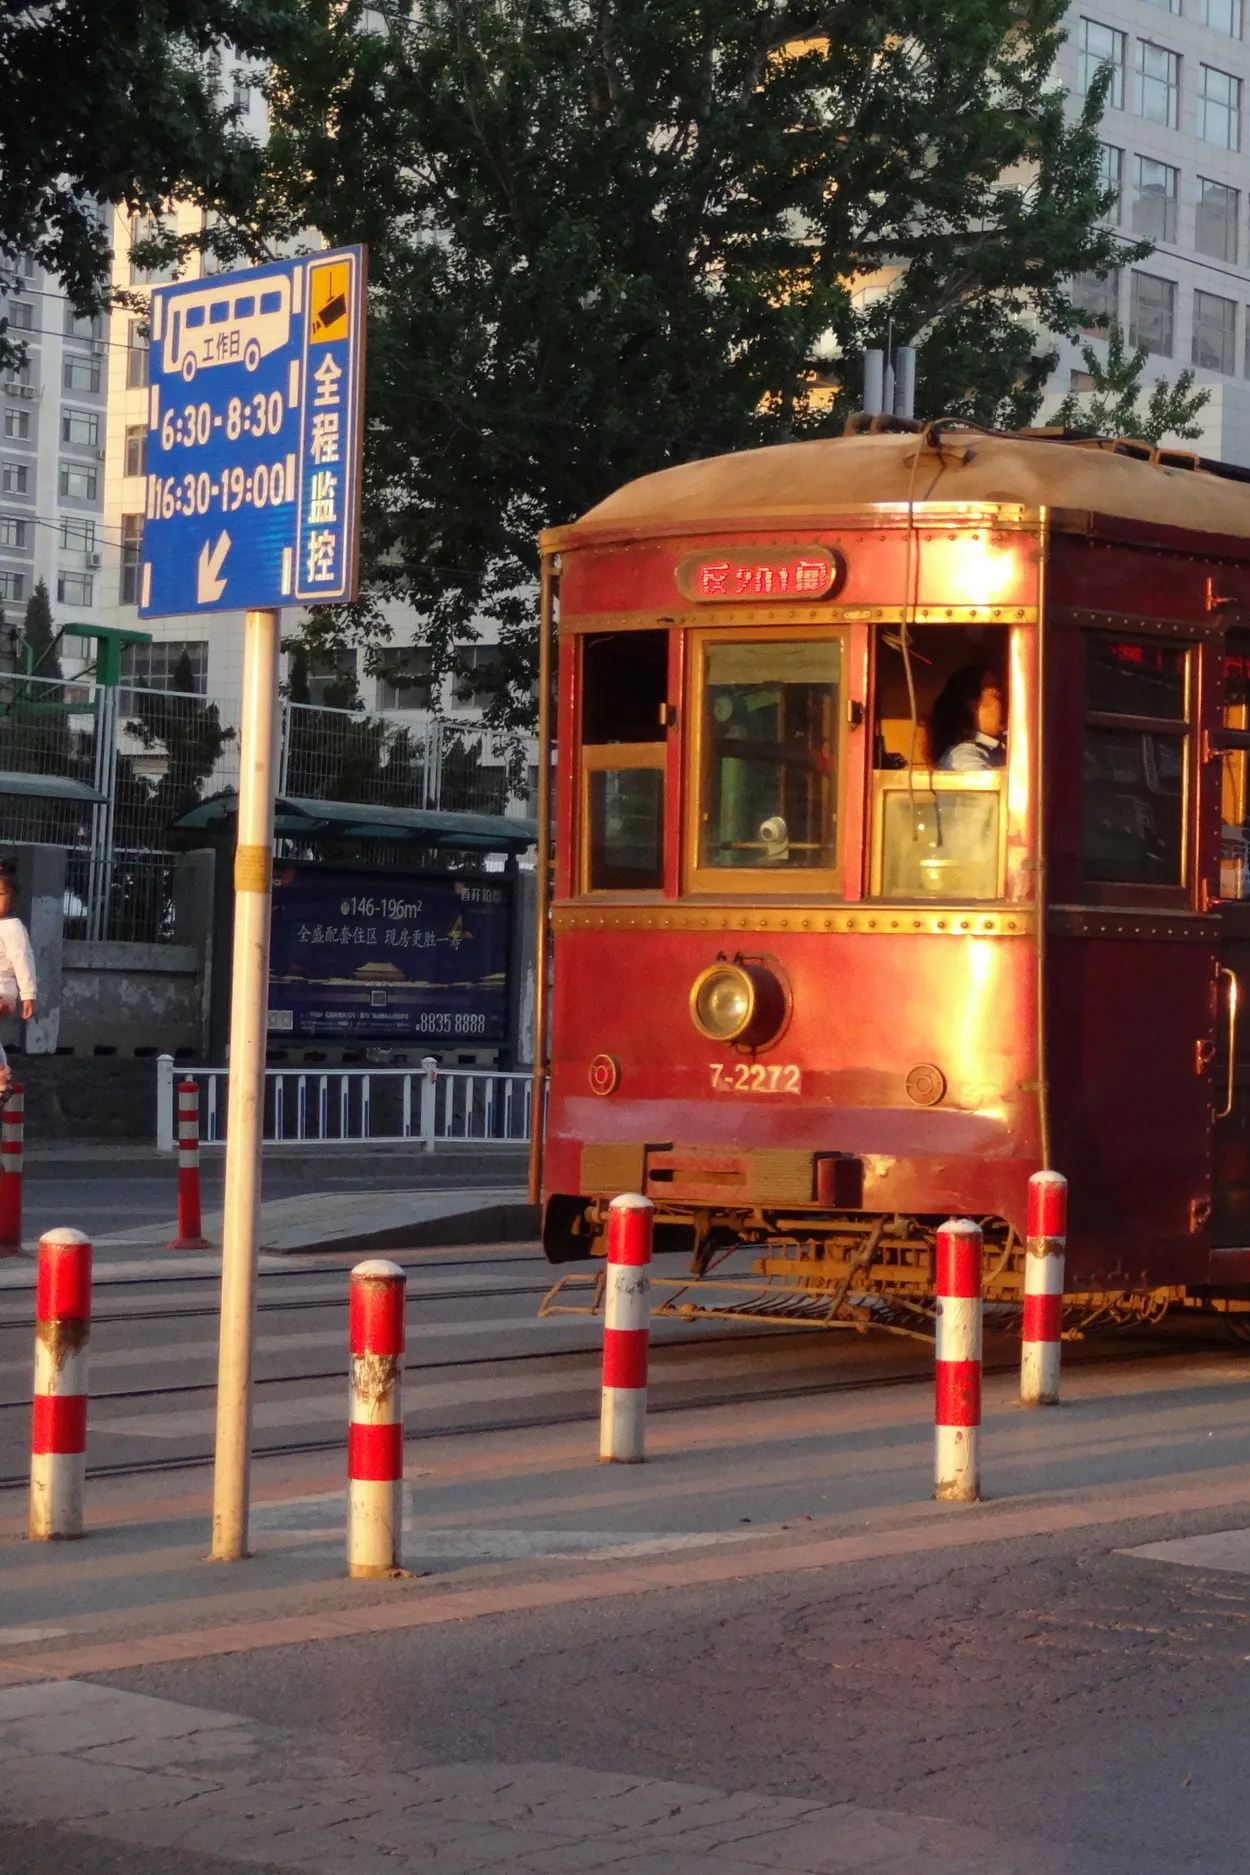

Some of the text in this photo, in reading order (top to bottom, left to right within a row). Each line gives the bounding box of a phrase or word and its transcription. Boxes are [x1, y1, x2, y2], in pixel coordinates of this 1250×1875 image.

[202, 330, 241, 362] 工作日
[161, 391, 283, 451] 6:30-8:30
[306, 352, 342, 584] 全程监控
[155, 462, 284, 521] 16:30-19:00
[420, 1012, 451, 1033] 8835
[454, 1013, 486, 1034] 8888
[709, 1063, 801, 1093] 7-2272
